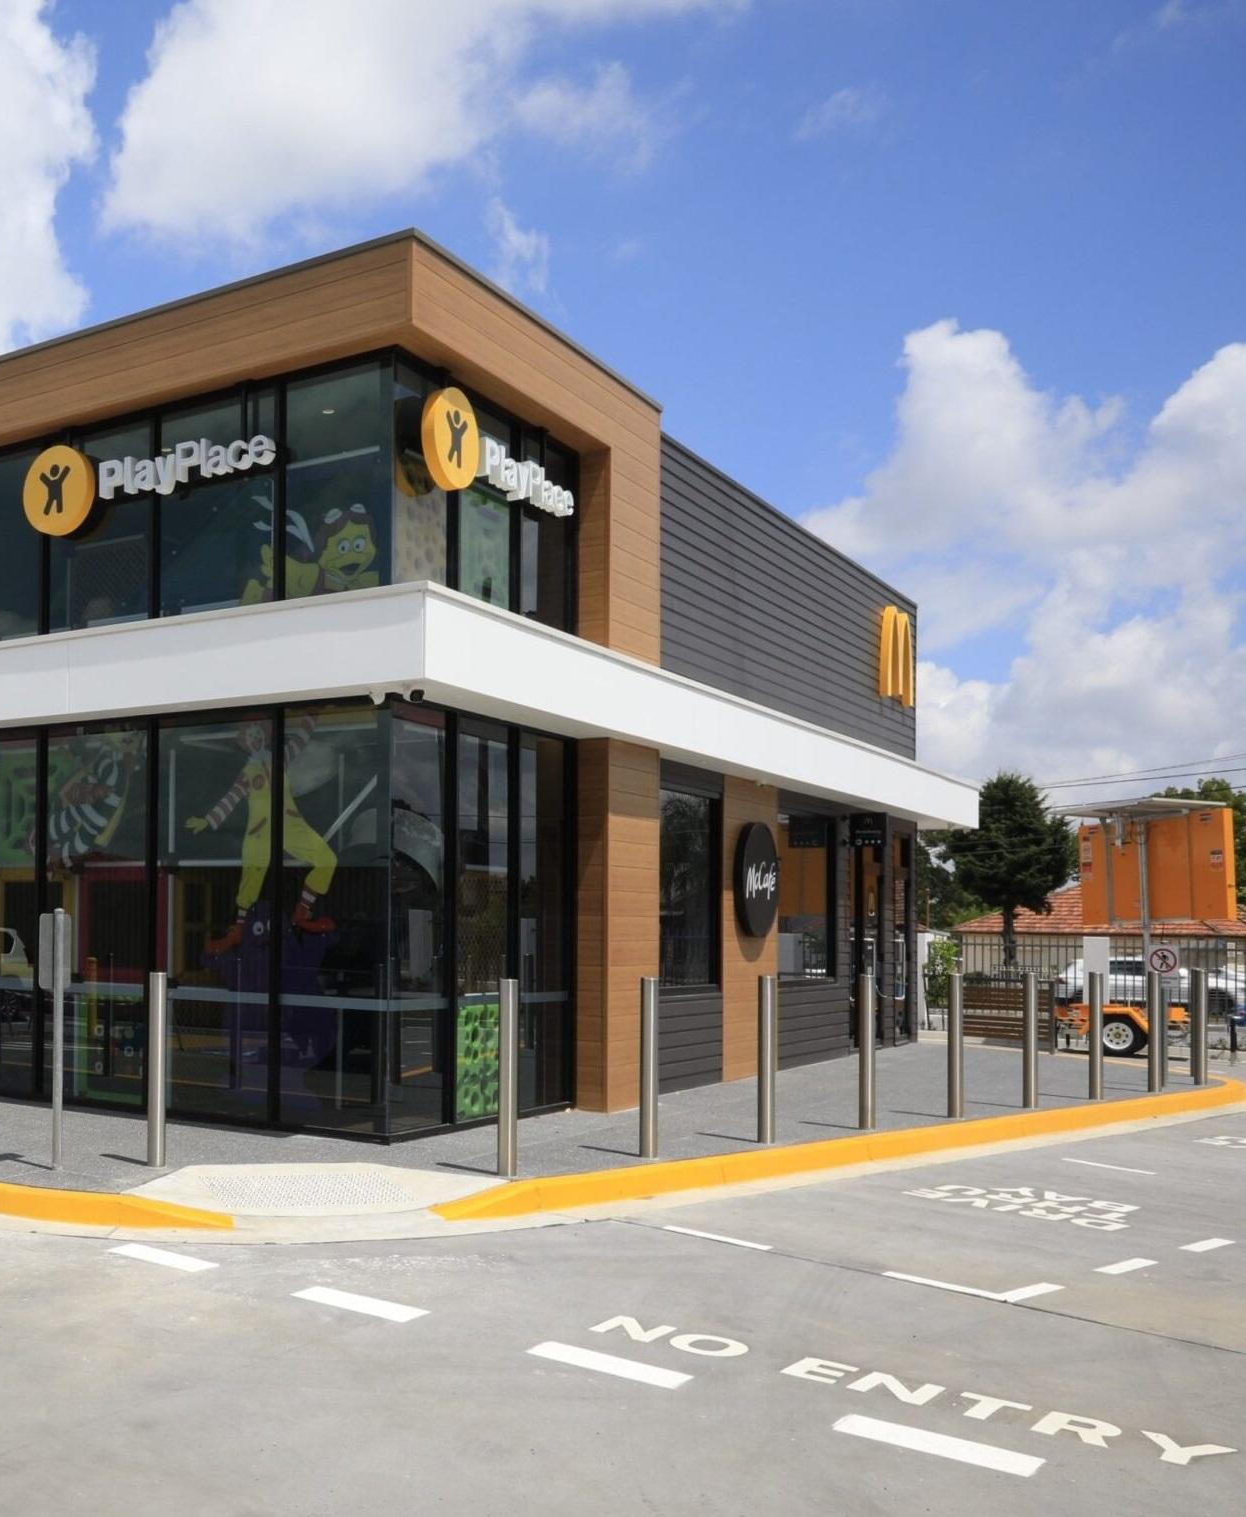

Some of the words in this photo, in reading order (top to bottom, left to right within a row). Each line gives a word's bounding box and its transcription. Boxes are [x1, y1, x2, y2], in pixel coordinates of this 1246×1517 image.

[99, 434, 276, 500] PlayPlace
[479, 436, 575, 517] PlayPlace
[745, 860, 777, 901] McCafé
[902, 1188, 1131, 1232] DRIVE
[934, 1184, 1128, 1223] THRU
[989, 1186, 1141, 1213] BAY
[588, 1315, 749, 1358] NO
[780, 1357, 1238, 1466] ENTRY
